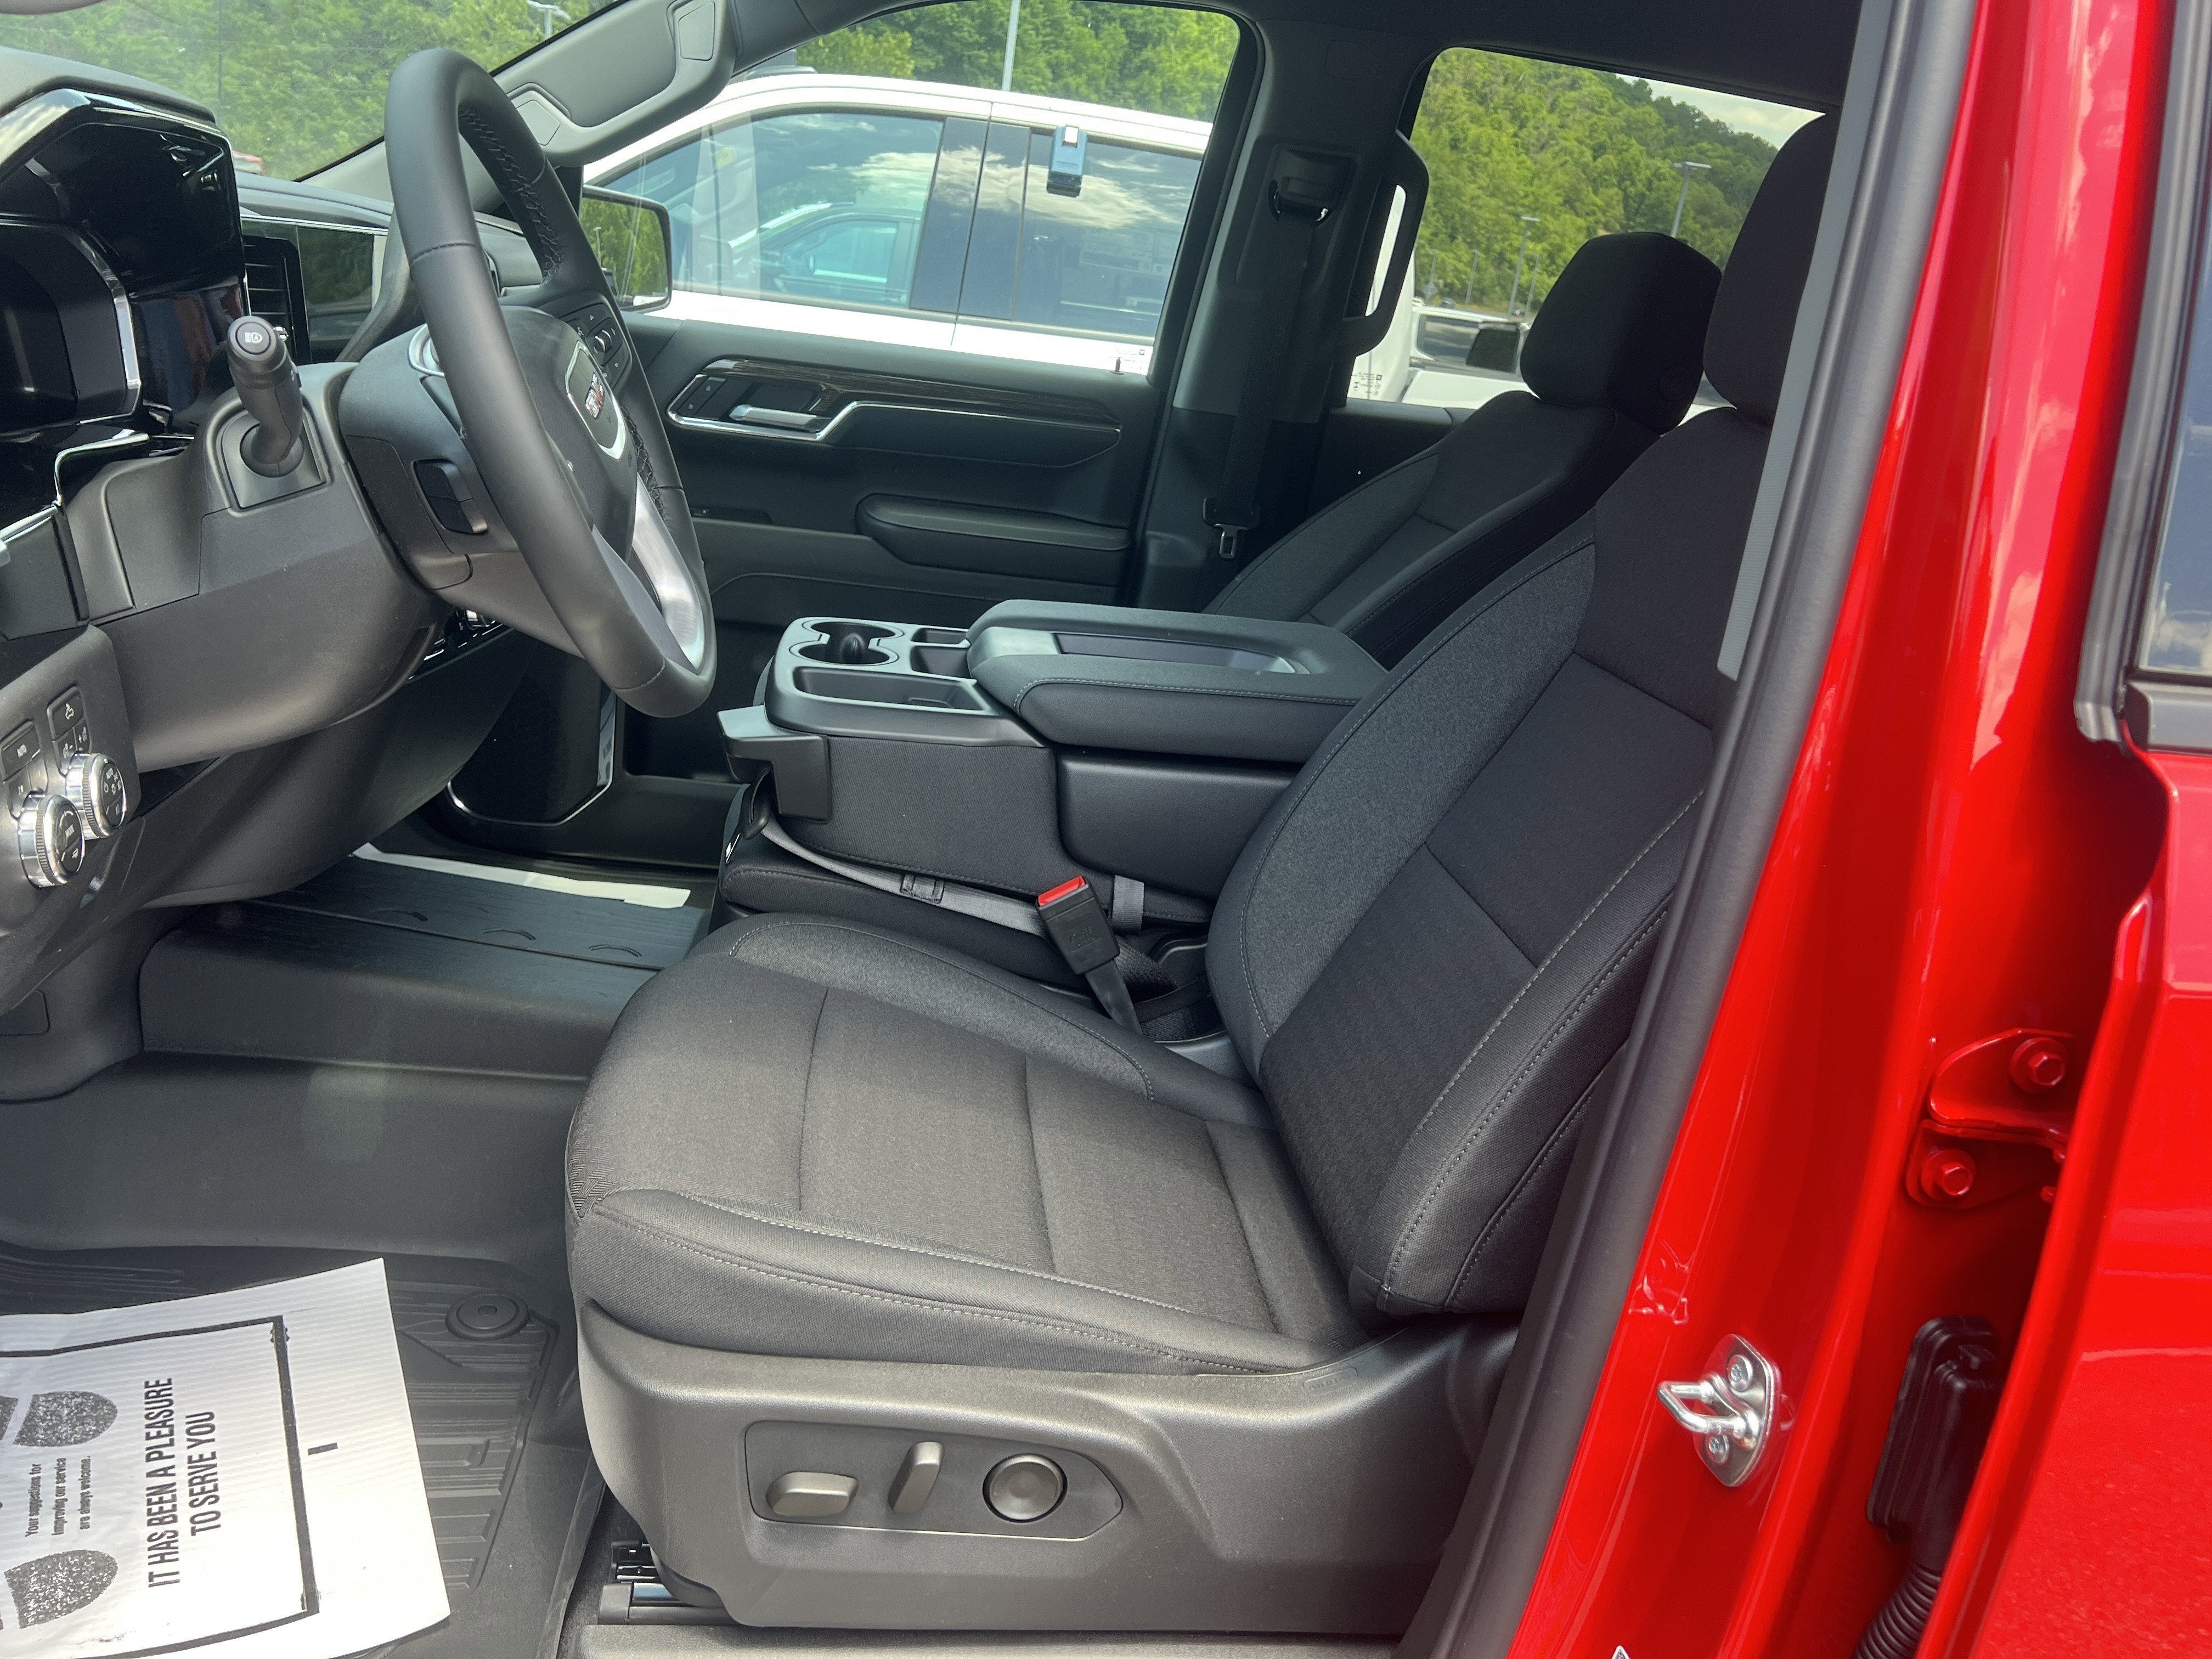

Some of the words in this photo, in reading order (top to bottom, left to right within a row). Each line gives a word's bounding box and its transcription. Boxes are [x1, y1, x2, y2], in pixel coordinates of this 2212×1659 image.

[143, 1378, 176, 1463] PLEASURE
[185, 1411, 216, 1450] YOU
[29, 1464, 42, 1475] for
[54, 1458, 66, 1484] service
[78, 1455, 91, 1490] welcome.
[145, 1465, 176, 1478] A
[187, 1451, 220, 1508] SERVE
[28, 1476, 43, 1516] suggestions
[55, 1486, 66, 1497] our
[77, 1491, 93, 1514] always
[146, 1482, 178, 1527] BEEN
[25, 1518, 39, 1537] Your
[80, 1516, 91, 1530] are
[189, 1510, 222, 1536] TO
[146, 1530, 179, 1566] HAS
[148, 1571, 180, 1588] IT
